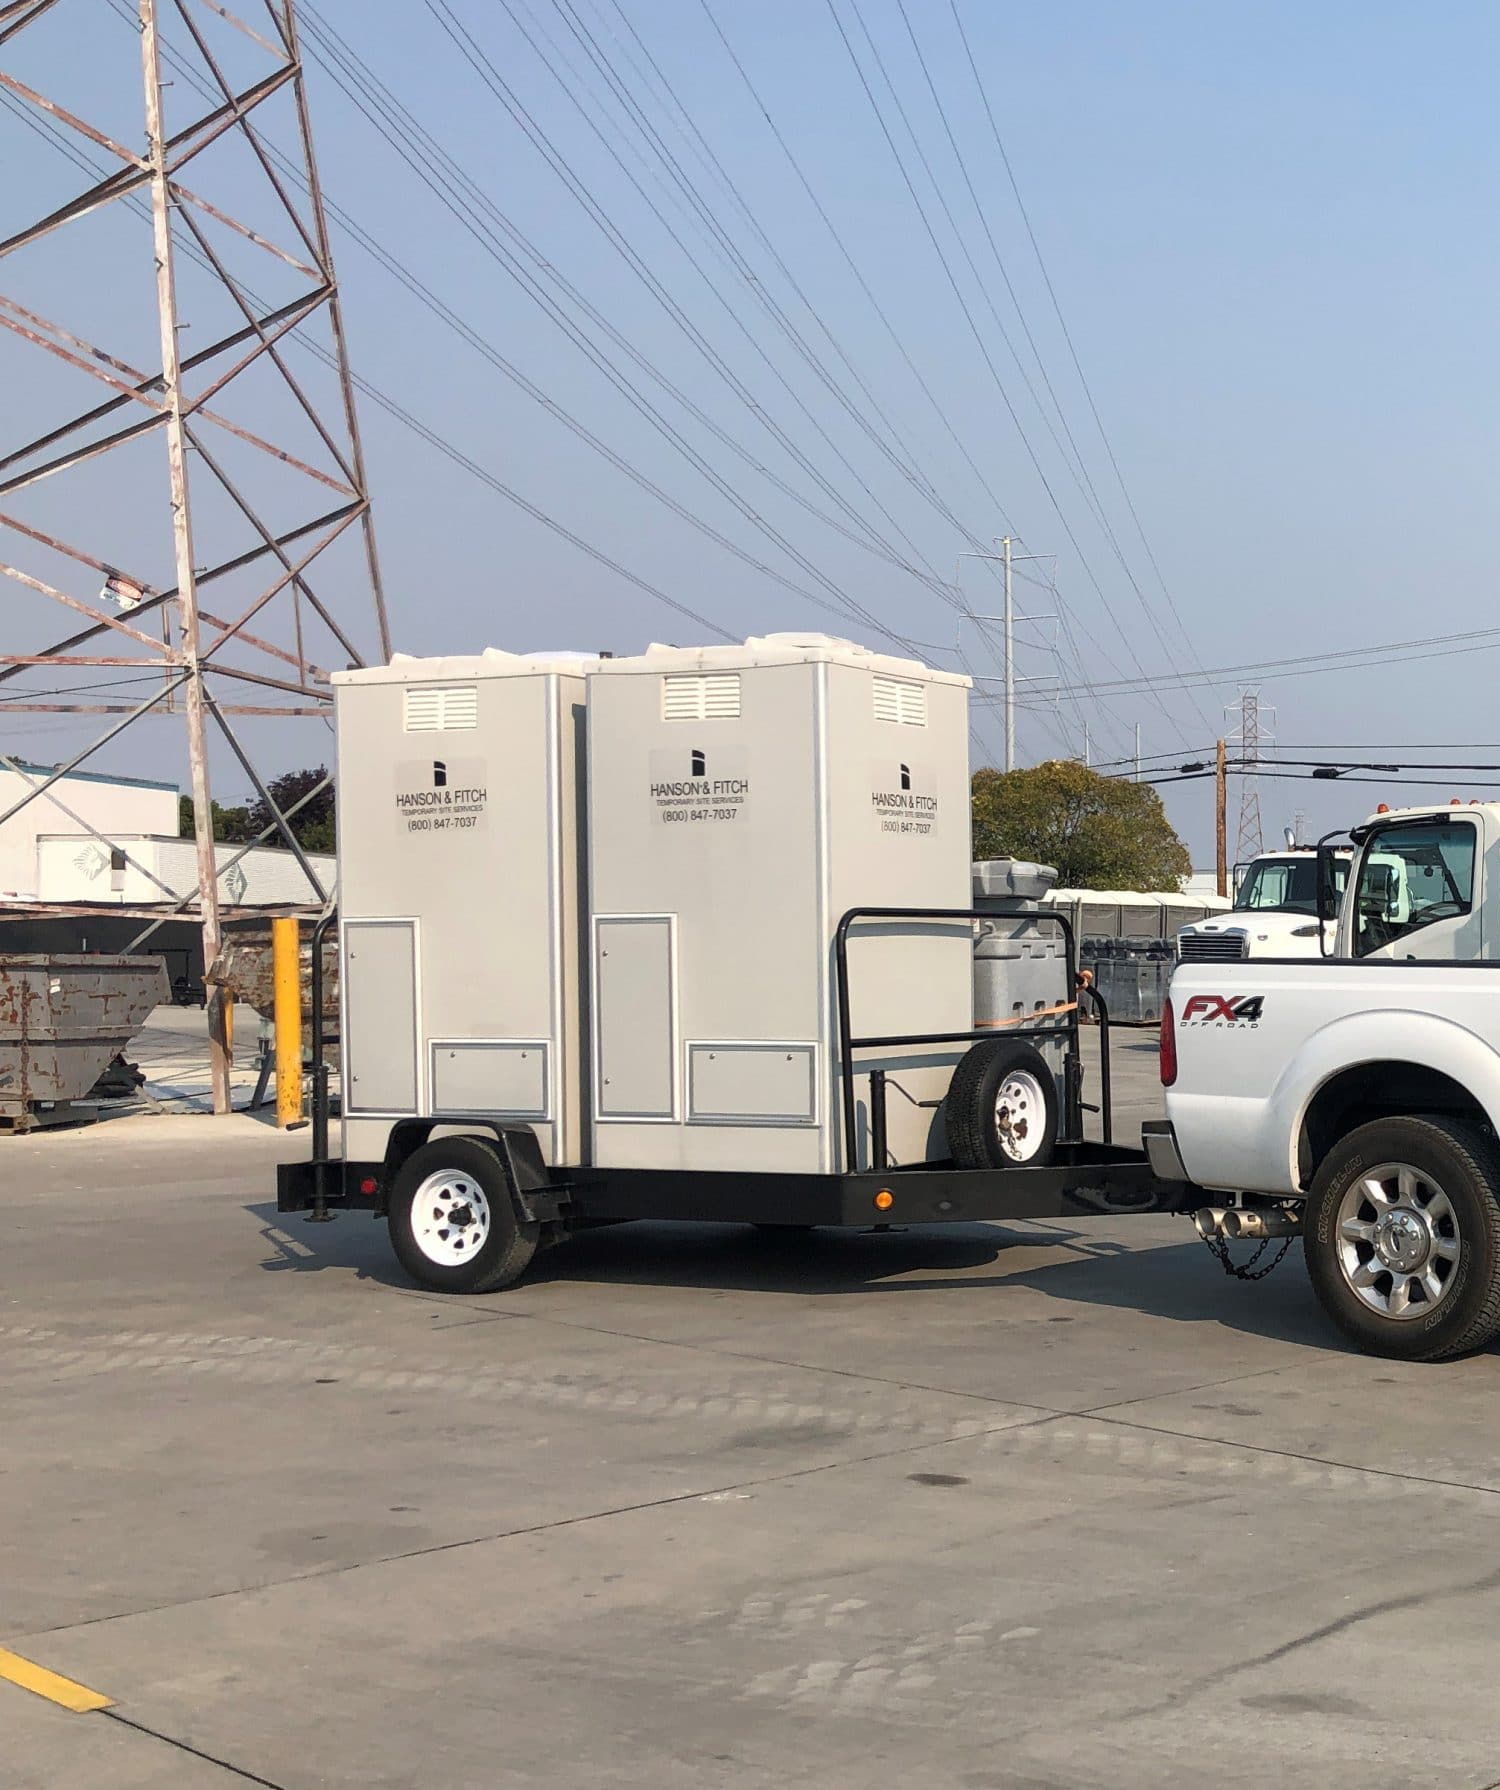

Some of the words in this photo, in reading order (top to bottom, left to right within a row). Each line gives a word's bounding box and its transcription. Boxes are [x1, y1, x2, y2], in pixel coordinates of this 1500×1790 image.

[396, 792, 442, 807] HANSON
[444, 790, 452, 804] &
[454, 788, 487, 803] FITCH
[650, 782, 700, 797] HANSON
[702, 781, 711, 795] &
[713, 780, 749, 795] FITCH
[871, 792, 907, 807] HANSON
[909, 795, 914, 808] &
[915, 796, 938, 811] FITCH
[401, 807, 437, 816] TEMPORARY
[438, 806, 452, 814] SITE
[662, 809, 688, 823] (800)
[690, 808, 737, 821] 847-7037
[407, 818, 432, 832] (800)
[434, 816, 477, 829] 847-7037
[1181, 995, 1265, 1021] FX4
[1317, 1154, 1364, 1244] MICHELIN
